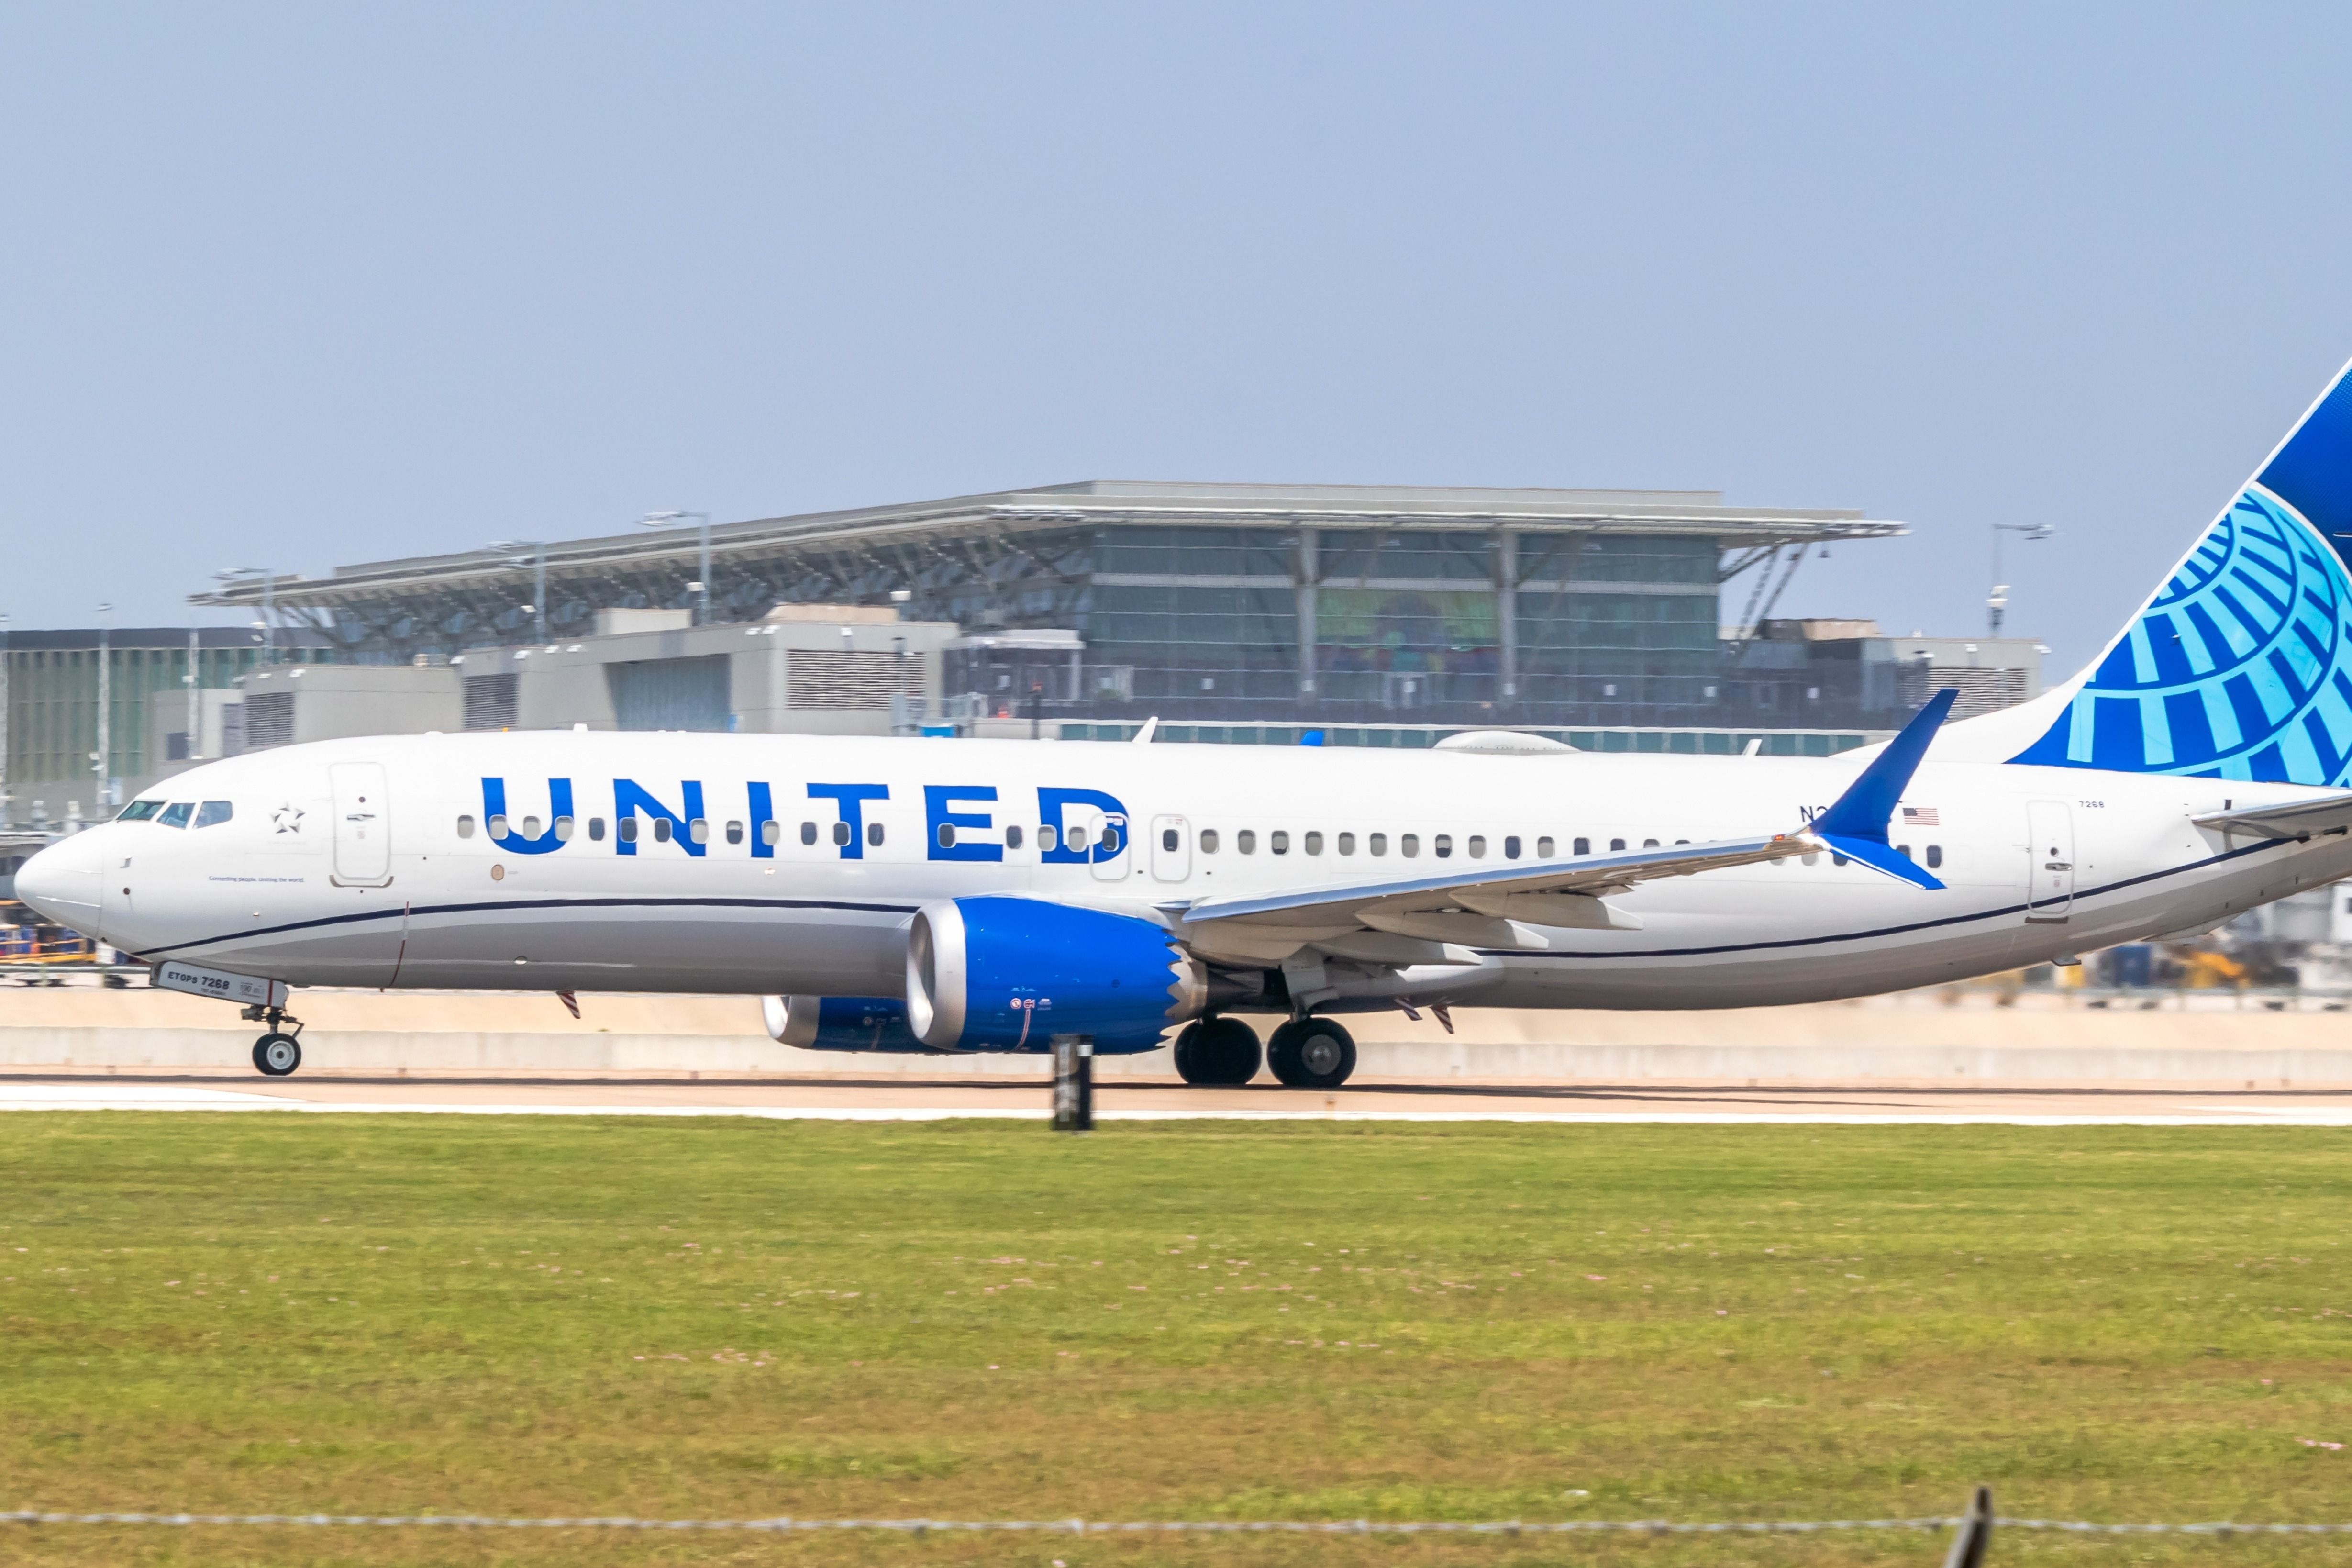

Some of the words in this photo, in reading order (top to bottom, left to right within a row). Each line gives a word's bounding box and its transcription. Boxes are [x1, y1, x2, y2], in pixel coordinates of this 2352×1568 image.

[481, 777, 1128, 864] UNITED
[168, 971, 198, 984] ETOPS
[201, 976, 230, 990] 7268
